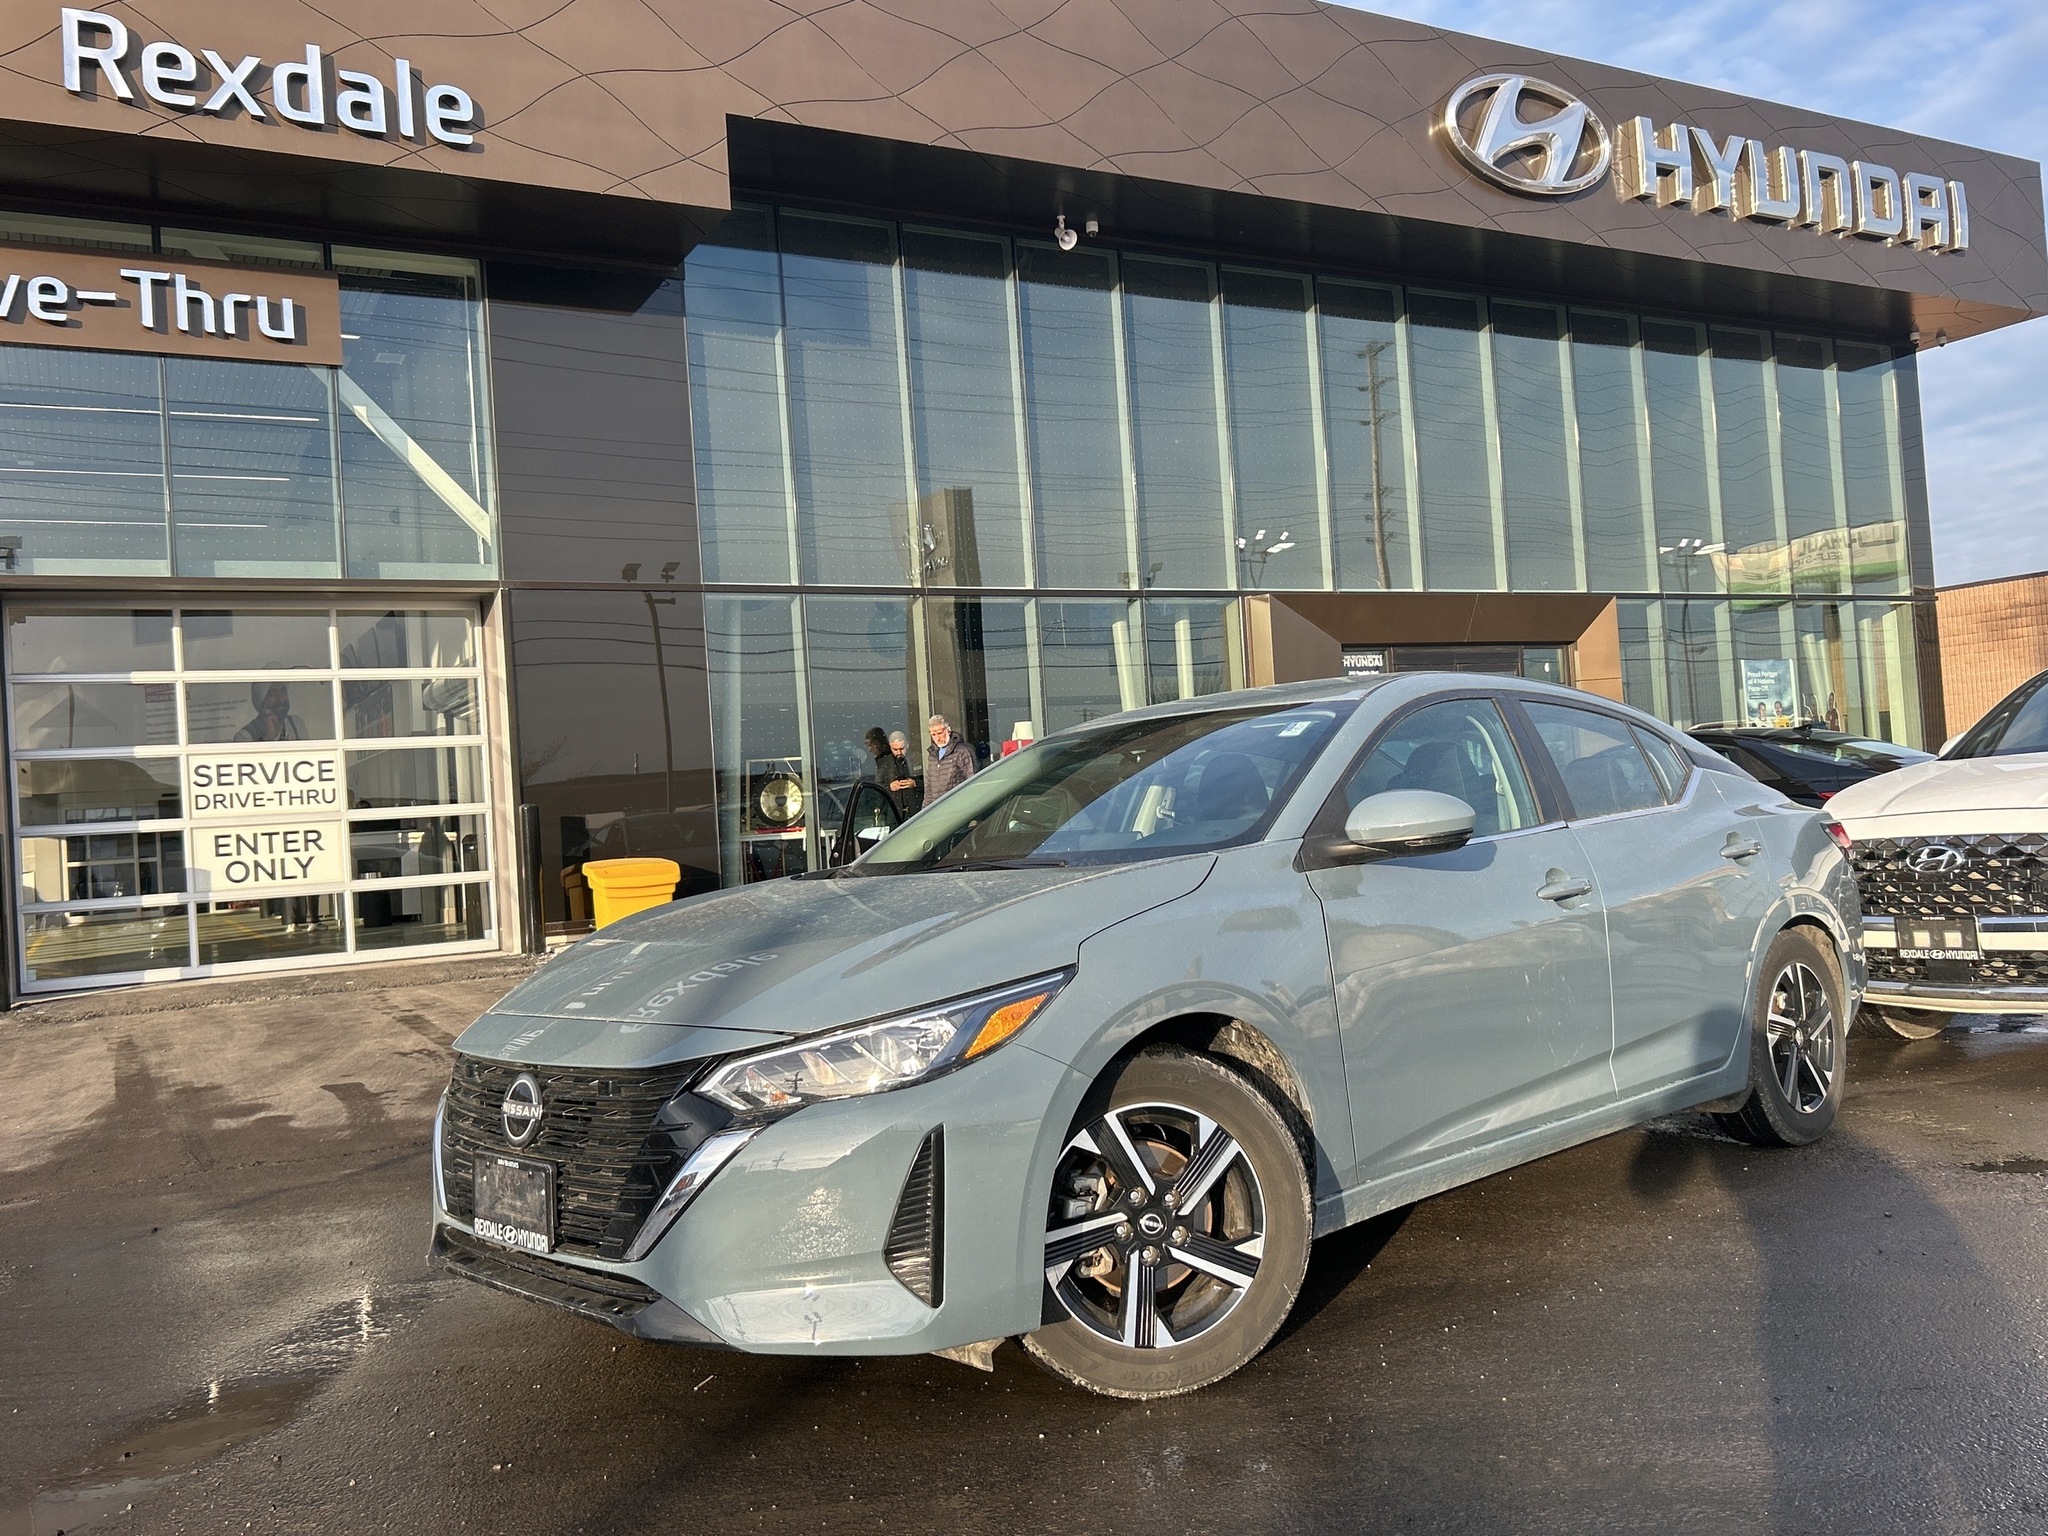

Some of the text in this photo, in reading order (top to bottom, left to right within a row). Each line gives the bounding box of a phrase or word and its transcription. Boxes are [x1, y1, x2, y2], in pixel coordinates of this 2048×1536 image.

[61, 7, 474, 146] Rexdale
[1630, 115, 1969, 252] HYUNDAI
[1343, 657, 1383, 667] HYUNDAI
[193, 760, 336, 788] SERVICE
[195, 788, 336, 810] DRIVE-THRU
[214, 829, 325, 858] ENTER
[225, 856, 315, 883] ONLY
[1900, 948, 1979, 960] REXDALE HYUNDAI
[502, 1102, 539, 1118] NISSAN
[474, 1217, 549, 1253] REXDALE HYUNDAI
